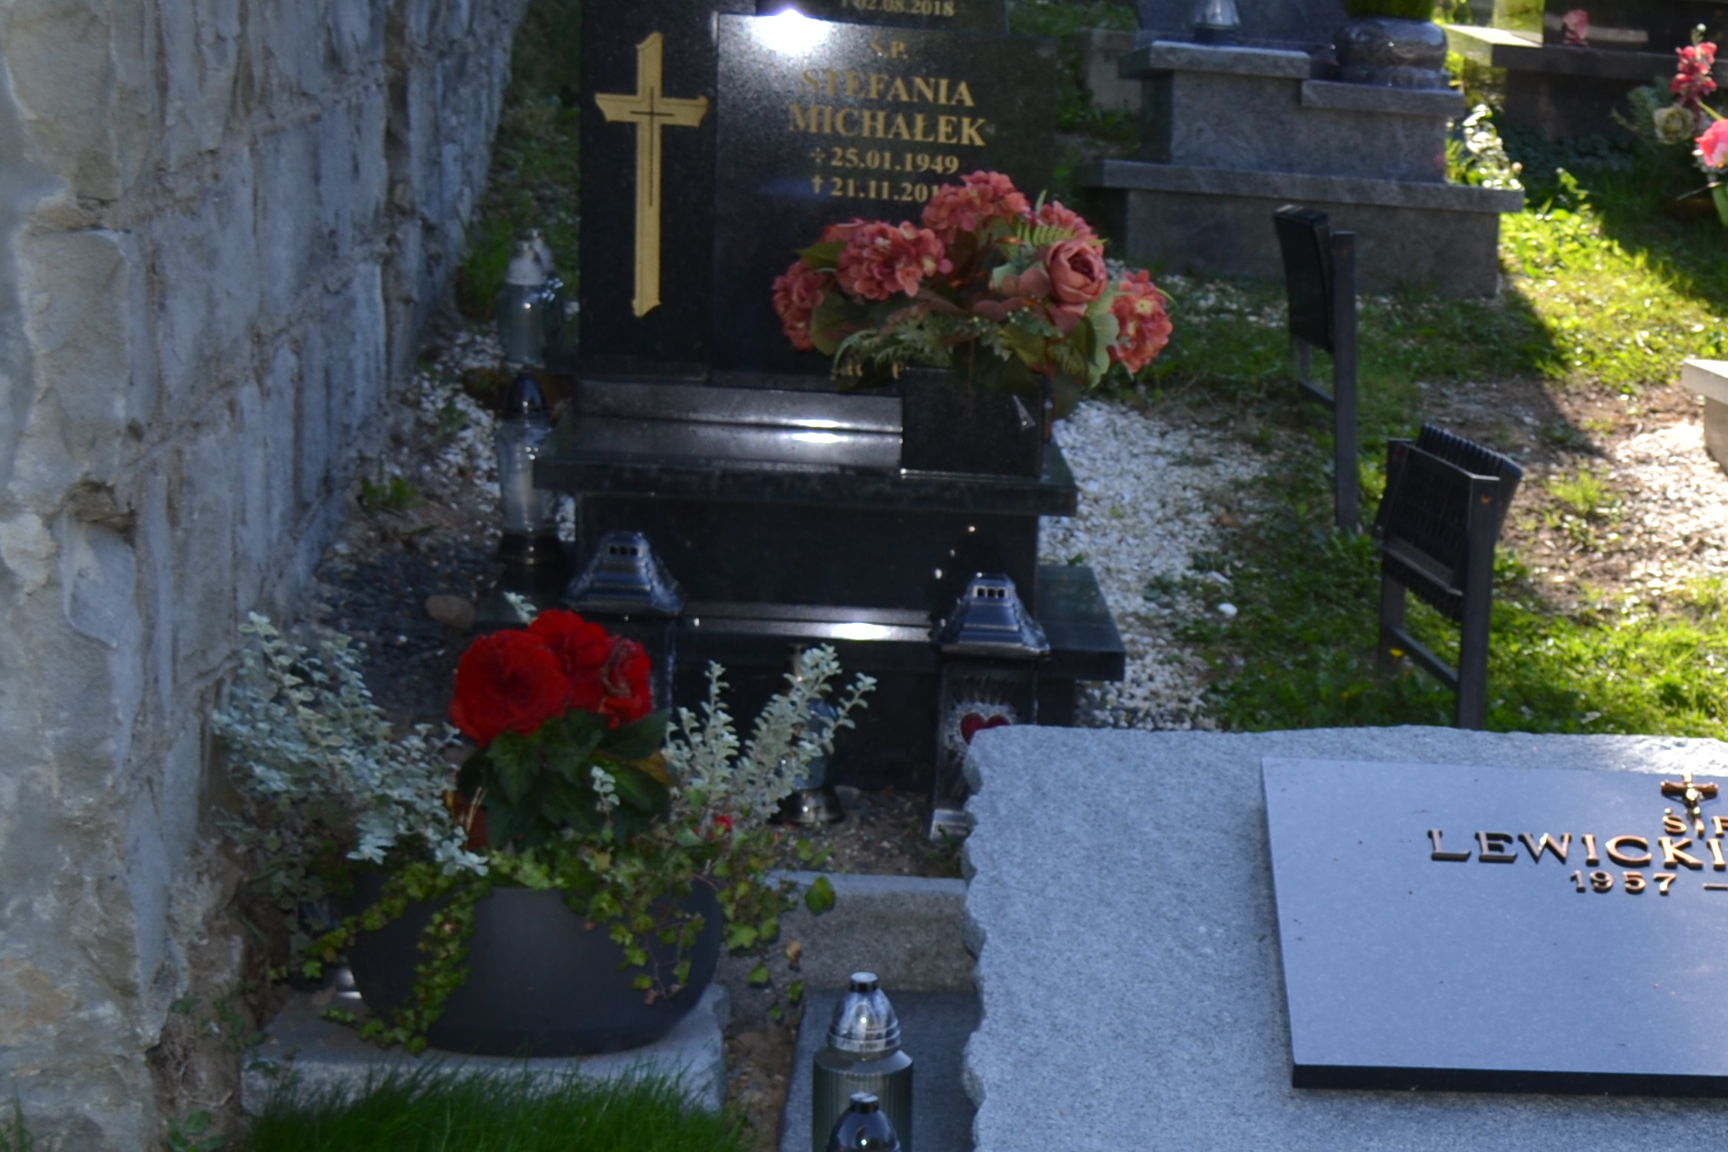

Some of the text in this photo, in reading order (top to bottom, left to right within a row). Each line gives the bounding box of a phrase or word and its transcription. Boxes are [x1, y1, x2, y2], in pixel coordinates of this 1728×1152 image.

[802, 70, 976, 107] STEFANIA
[788, 103, 987, 146] MICHAŁEK
[1427, 828, 1728, 871] LEWICKI
[1570, 870, 1677, 895] 1957
